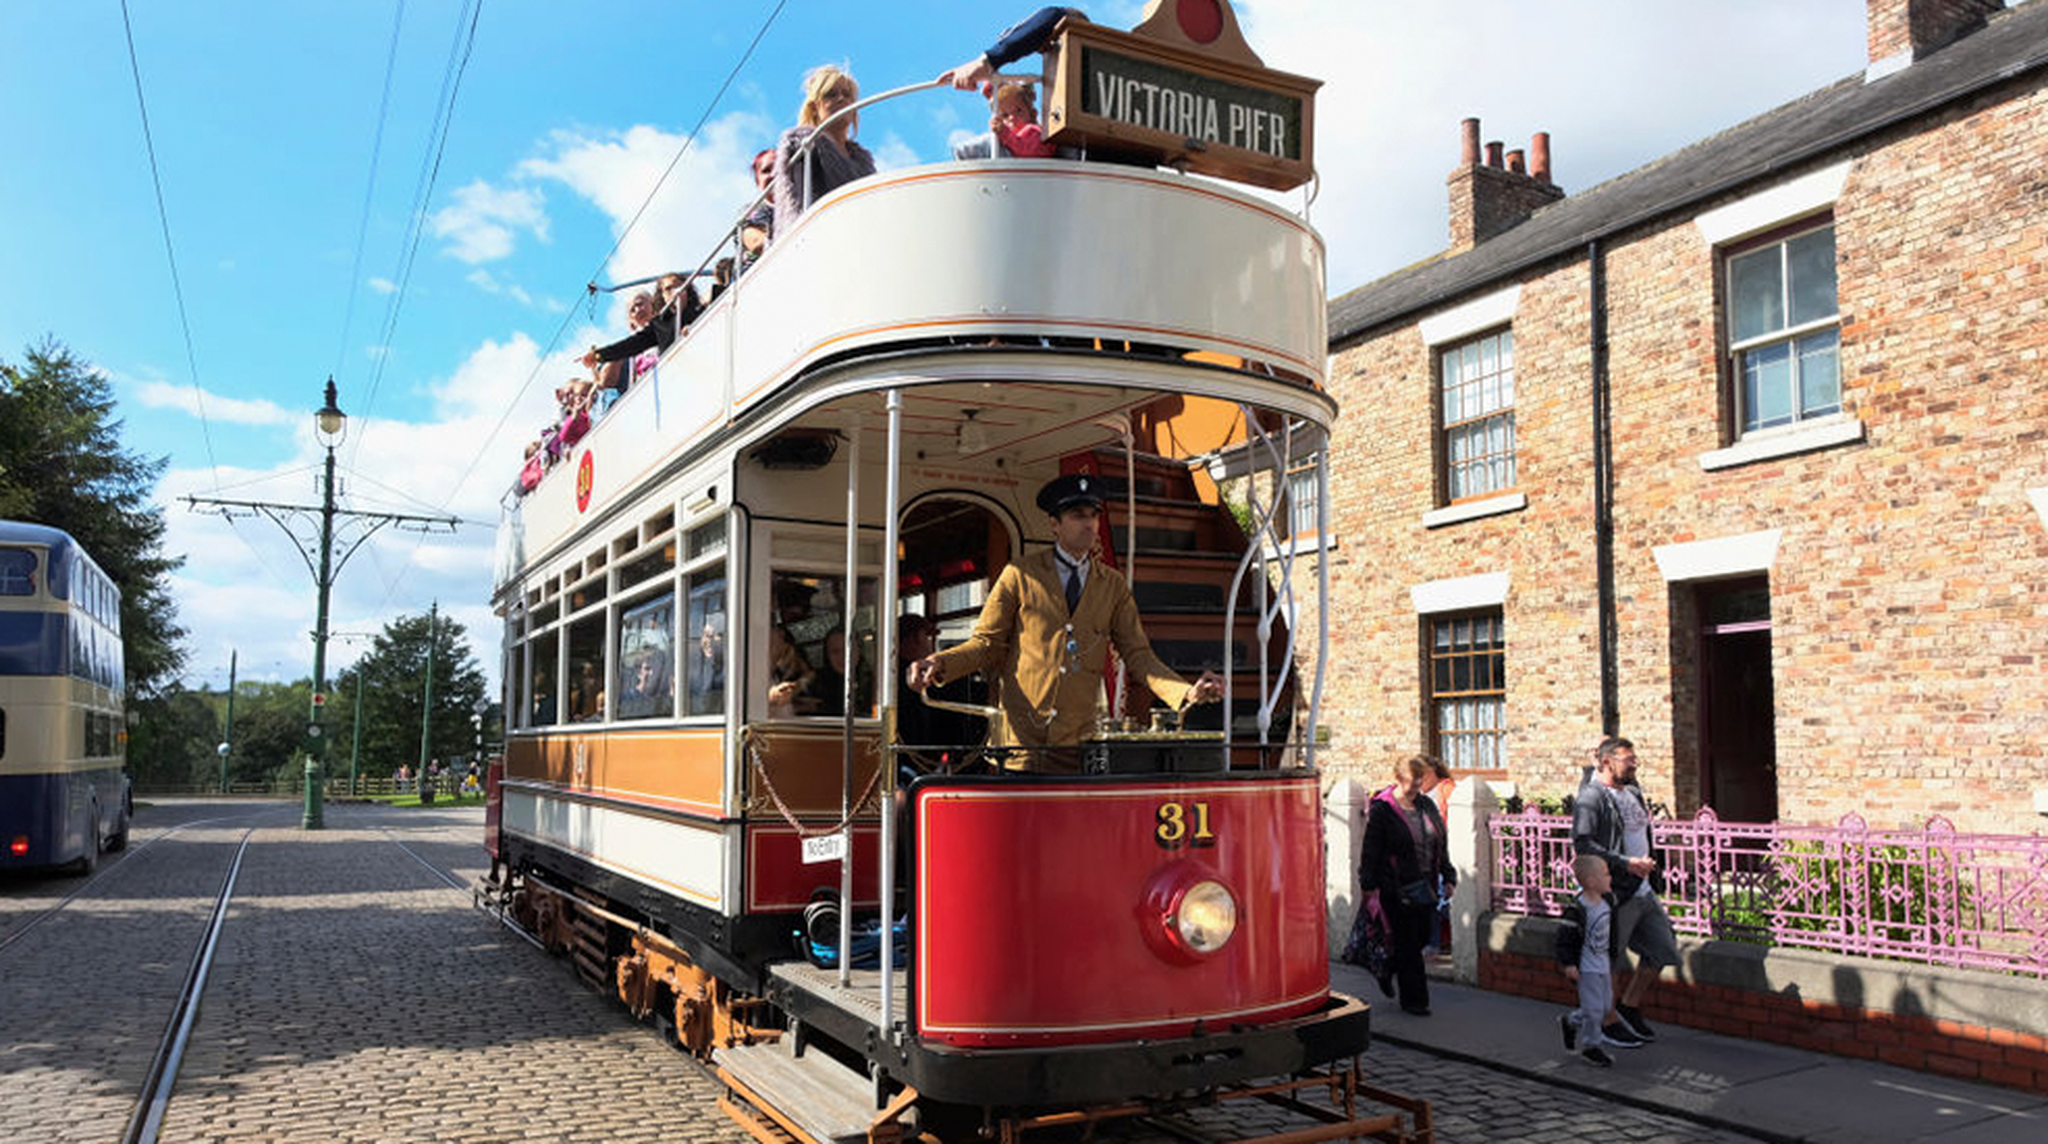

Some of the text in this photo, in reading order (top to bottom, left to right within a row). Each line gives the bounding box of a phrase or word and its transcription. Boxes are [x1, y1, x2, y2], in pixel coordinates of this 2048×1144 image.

[1097, 72, 1286, 157] VICTORIA PIER
[1157, 802, 1214, 842] 31
